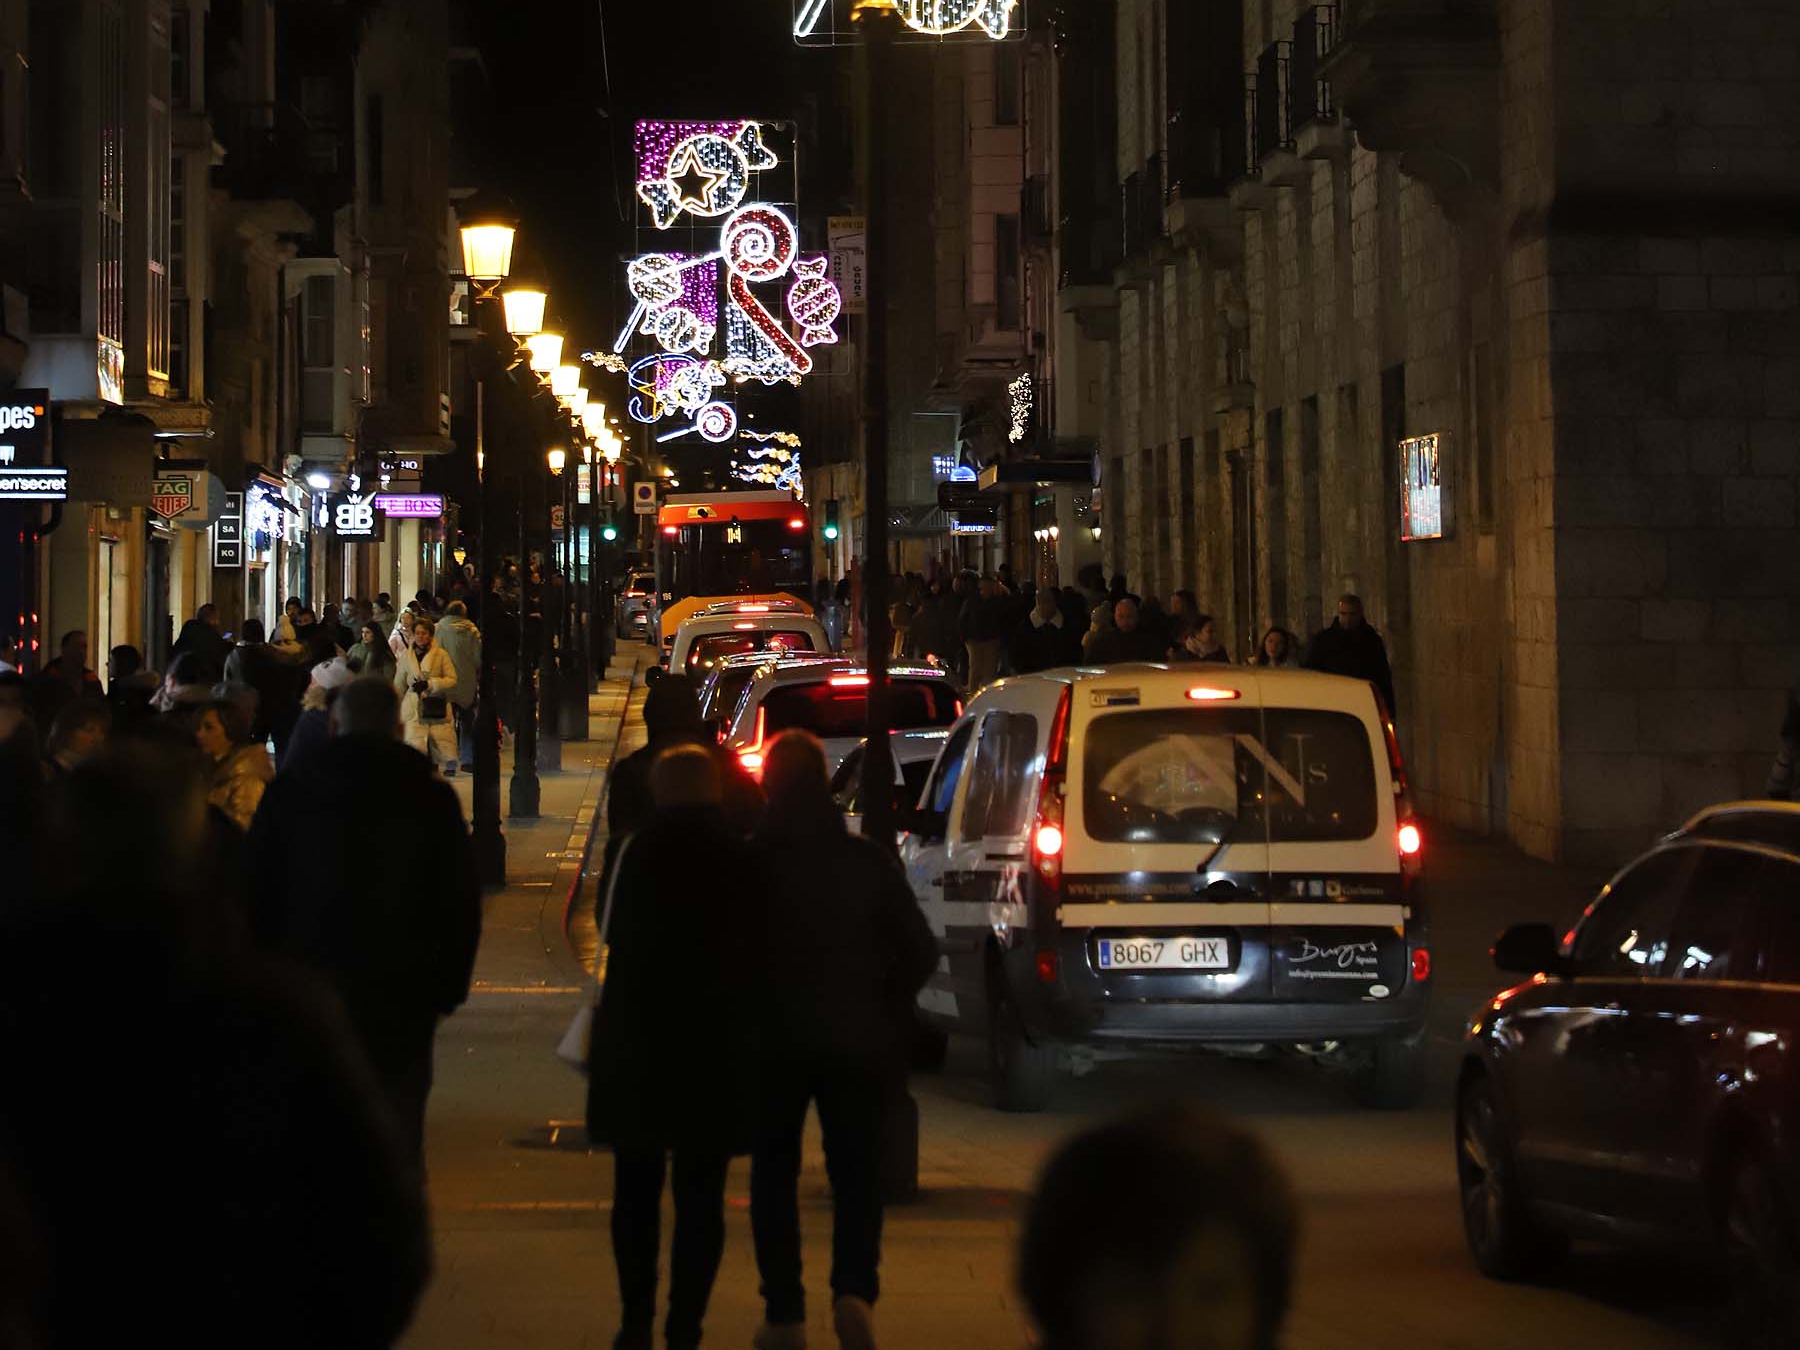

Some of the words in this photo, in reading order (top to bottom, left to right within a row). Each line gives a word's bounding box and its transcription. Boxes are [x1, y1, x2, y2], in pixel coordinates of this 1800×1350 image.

[152, 482, 187, 494] TAG
[222, 525, 235, 533] SA
[221, 549, 235, 557] KO
[1114, 943, 1164, 964] 8067
[1181, 942, 1219, 963] GHX
